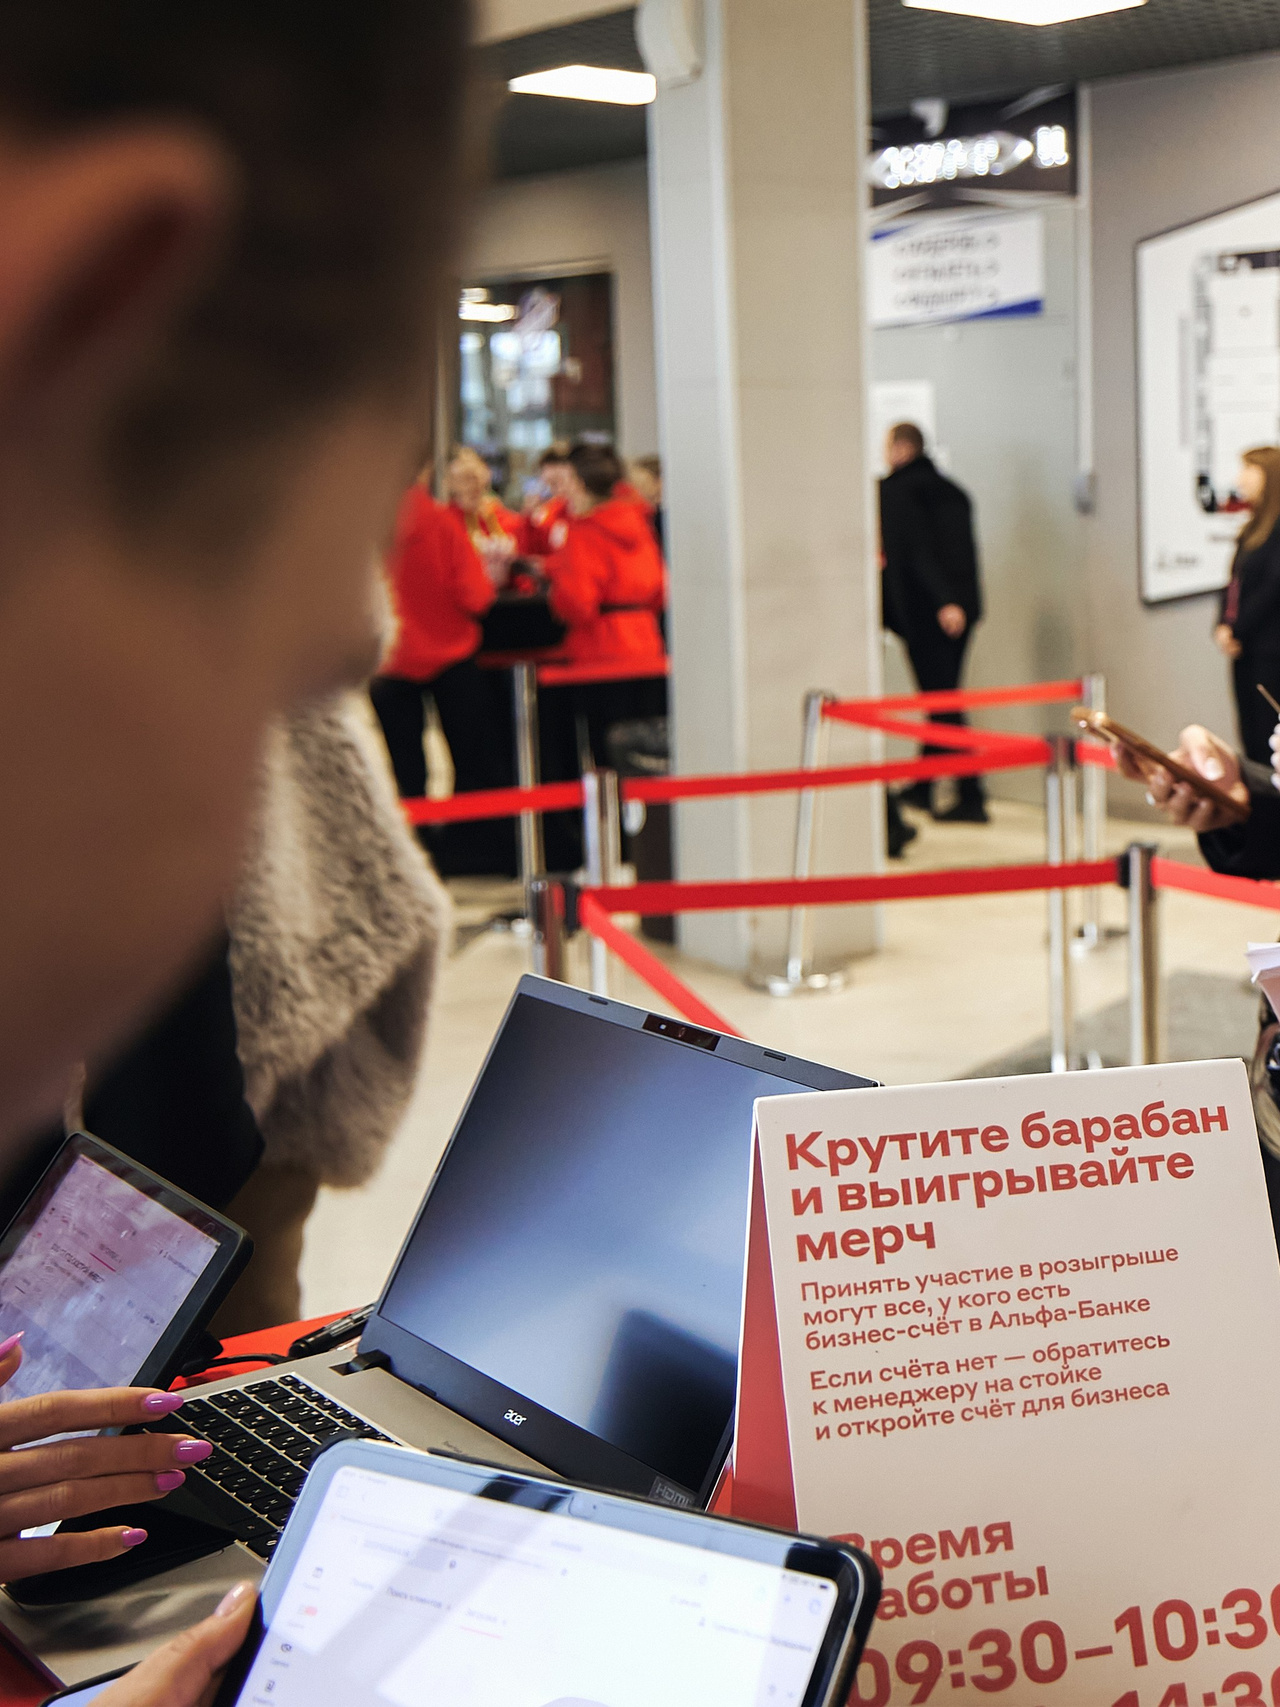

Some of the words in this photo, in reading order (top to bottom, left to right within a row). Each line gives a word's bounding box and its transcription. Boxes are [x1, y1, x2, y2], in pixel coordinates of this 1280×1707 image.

[786, 1125, 1009, 1178] Крутите
[1020, 1100, 1229, 1150] барабан
[791, 1186, 823, 1216] и
[837, 1146, 1195, 1209] выигрывайте
[796, 1221, 936, 1265] мерч
[801, 1279, 910, 1303] Принять
[914, 1266, 1013, 1293] участие
[1020, 1264, 1033, 1279] в
[1038, 1248, 1178, 1276] розыгрыше
[803, 1304, 877, 1328] могут
[884, 1298, 933, 1319] все,
[937, 1296, 951, 1316] у
[958, 1290, 1011, 1309] кого
[1017, 1284, 1071, 1303] есть
[804, 1316, 961, 1350] бизнес-счёт
[969, 1317, 982, 1332] в
[988, 1298, 1150, 1331] Альфа-Банке
[810, 1370, 873, 1391] Если
[878, 1356, 950, 1387] счёта
[955, 1354, 998, 1373] нет
[1032, 1333, 1171, 1364] обратитесь
[812, 1400, 827, 1415] к
[833, 1379, 978, 1413] менеджеру
[985, 1378, 1014, 1394] на
[1019, 1363, 1102, 1388] стойке
[503, 1408, 527, 1426] acer
[815, 1425, 831, 1440] и
[836, 1405, 954, 1435] откройте
[960, 1396, 1015, 1423] счёт
[1021, 1395, 1065, 1417] для
[1070, 1379, 1171, 1406] бизнеса
[875, 1564, 1049, 1621] аботы
